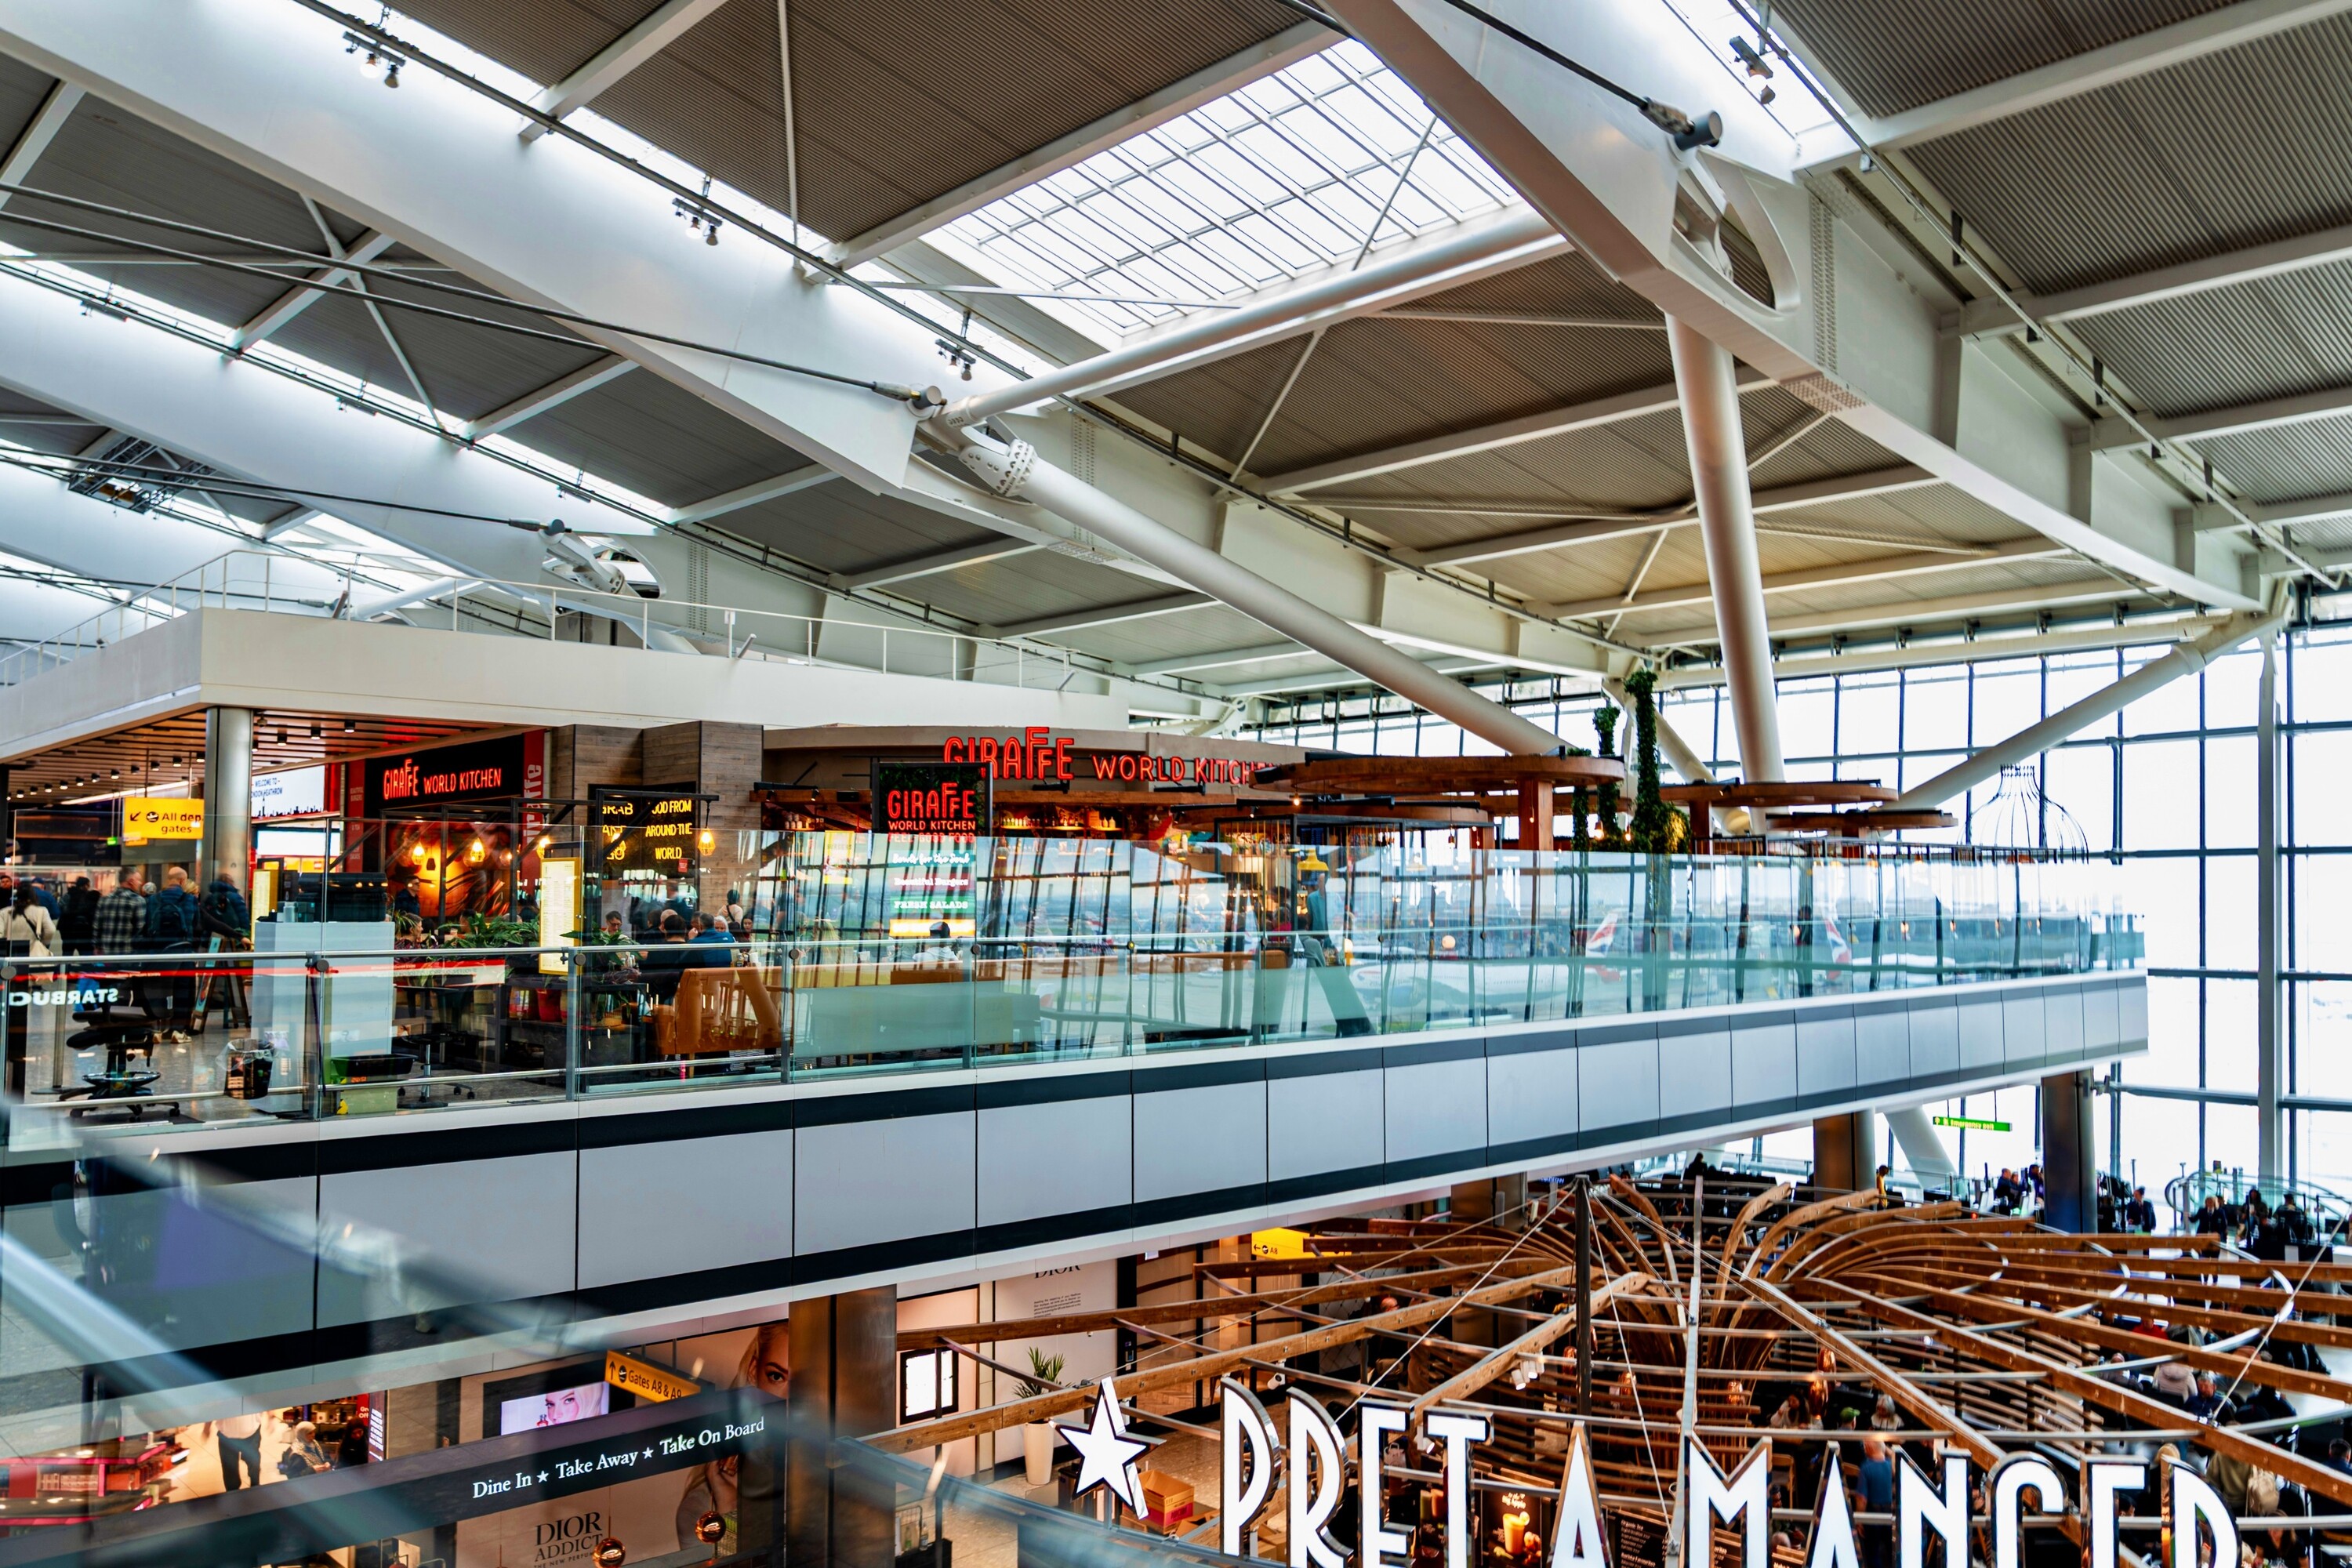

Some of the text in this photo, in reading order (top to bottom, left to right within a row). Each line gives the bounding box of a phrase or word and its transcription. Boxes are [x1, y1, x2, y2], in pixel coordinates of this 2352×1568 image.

[943, 726, 1283, 785] GIRAFFE WORLD KITCH
[255, 779, 270, 787] WELCOME
[383, 758, 502, 800] GIRAFFE WORLD KITCHEN
[670, 800, 691, 813] FROM
[887, 782, 975, 818] GIRAFFE
[162, 812, 204, 826] All dep
[888, 820, 976, 830] WORLD KITCHEN
[161, 825, 192, 834] gates
[645, 824, 677, 837] AROUND
[949, 833, 975, 843] FOOD
[655, 847, 683, 860] WORLD
[894, 901, 969, 909] FRESH SALADS
[628, 1370, 650, 1389] Gates
[652, 1380, 662, 1395] A8
[663, 1384, 670, 1398] &
[472, 1417, 765, 1499] Dine In Take Away Take On Board
[1221, 1380, 1491, 1568] PRET
[1550, 1423, 1610, 1568] A
[535, 1512, 603, 1546] DIOR
[534, 1534, 603, 1563] ADDICT
[568, 1552, 592, 1561] PERFU
